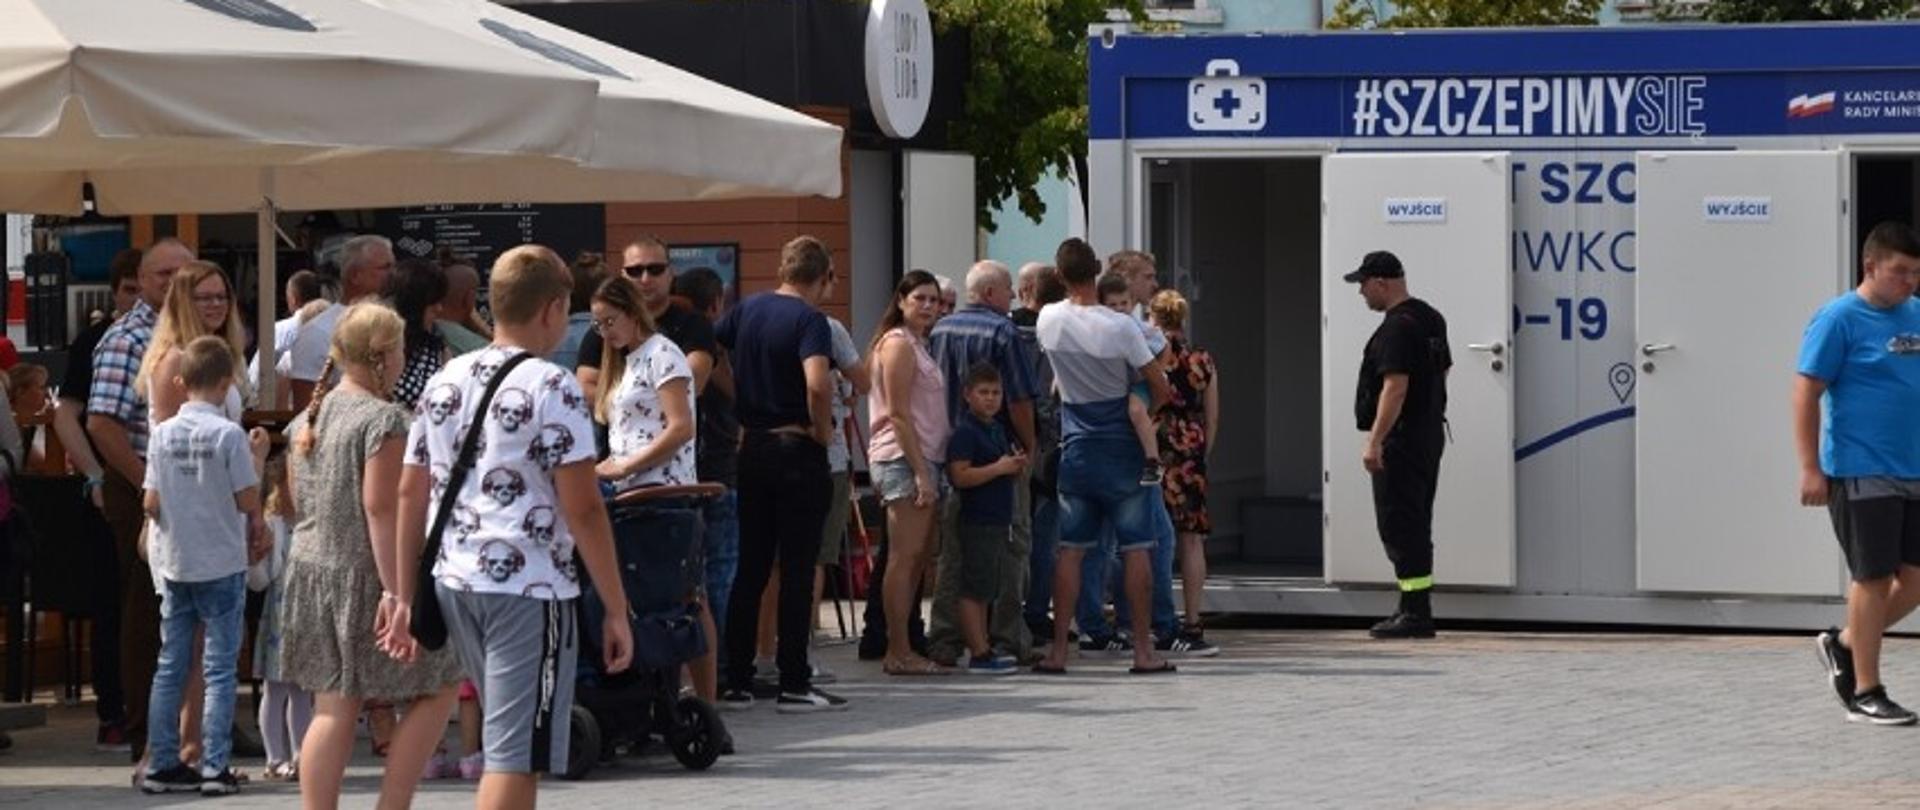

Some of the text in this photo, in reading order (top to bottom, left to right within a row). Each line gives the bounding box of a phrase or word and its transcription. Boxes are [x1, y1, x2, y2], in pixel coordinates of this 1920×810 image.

[1843, 106, 1880, 118] RADY
[1387, 201, 1443, 216] WYJŚCIE
[1707, 201, 1768, 216] WYJŚCIE
